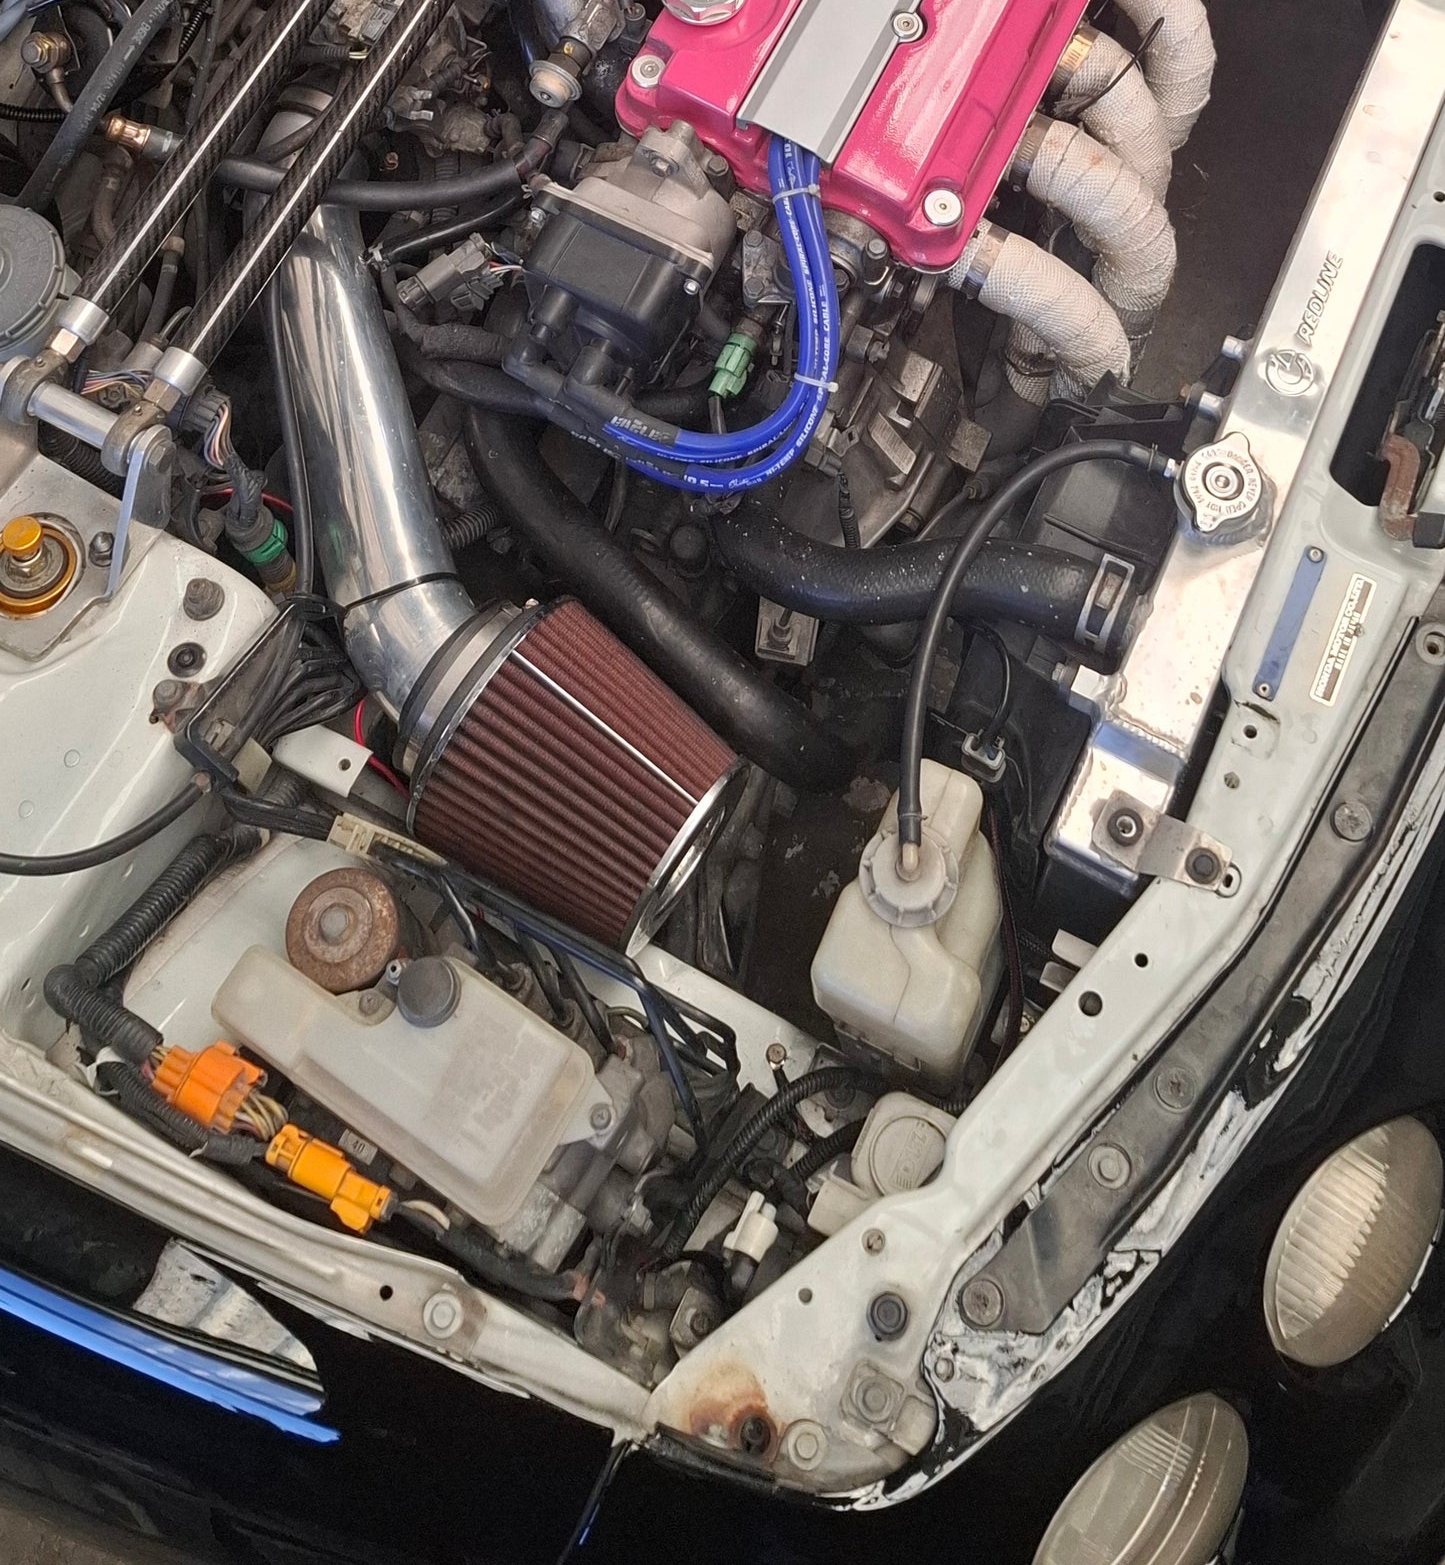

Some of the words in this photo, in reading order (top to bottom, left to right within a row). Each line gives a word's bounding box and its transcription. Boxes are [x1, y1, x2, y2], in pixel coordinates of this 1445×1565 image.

[820, 300, 831, 332] CABLE
[1294, 250, 1344, 348] REDLINE
[817, 336, 831, 402] SPRAL-CORE
[796, 403, 819, 447] SILICONE
[765, 448, 795, 476] HI-TEMP
[1314, 656, 1337, 696] HONDA
[1329, 616, 1351, 656] MOTOR
